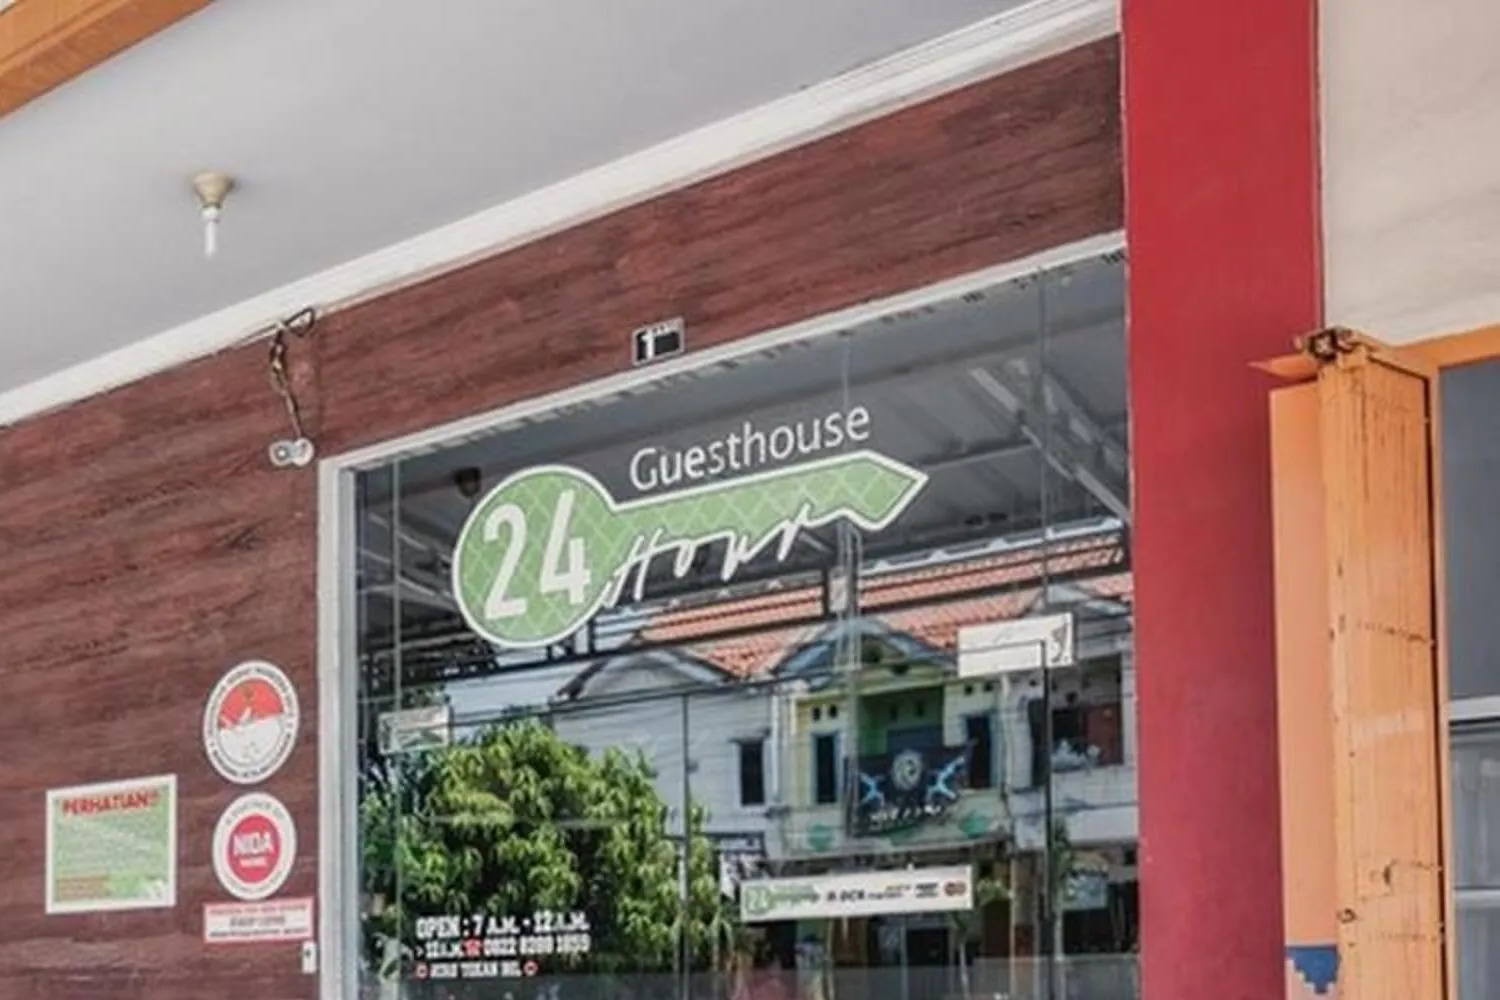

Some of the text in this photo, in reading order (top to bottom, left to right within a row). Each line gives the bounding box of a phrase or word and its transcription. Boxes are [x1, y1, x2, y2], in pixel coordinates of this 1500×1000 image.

[629, 405, 871, 491] Guesthouse
[482, 489, 591, 620] 24
[416, 915, 461, 939] OPEN
[472, 914, 483, 935] 7
